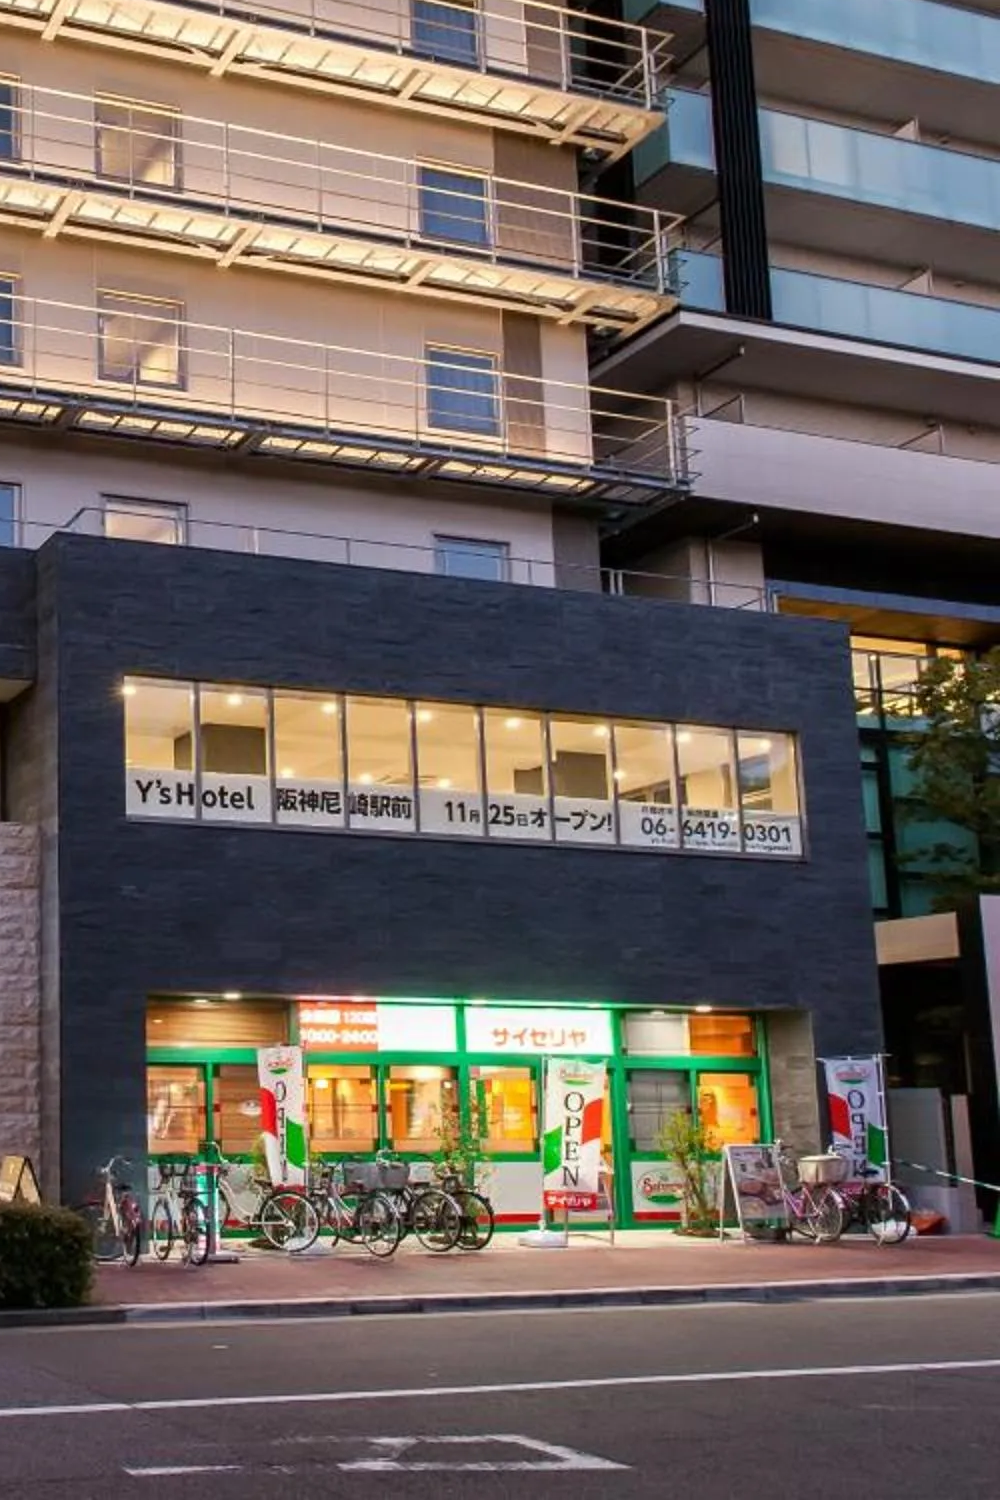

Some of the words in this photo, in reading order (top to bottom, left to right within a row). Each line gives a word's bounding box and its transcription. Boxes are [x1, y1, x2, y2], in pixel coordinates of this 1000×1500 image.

[135, 779, 172, 806] Y's
[176, 782, 255, 811] Hotel
[276, 787, 412, 820] 阪神尼崎駅前
[641, 817, 792, 843] 06-6419-0301
[562, 1091, 585, 1188] OPEN
